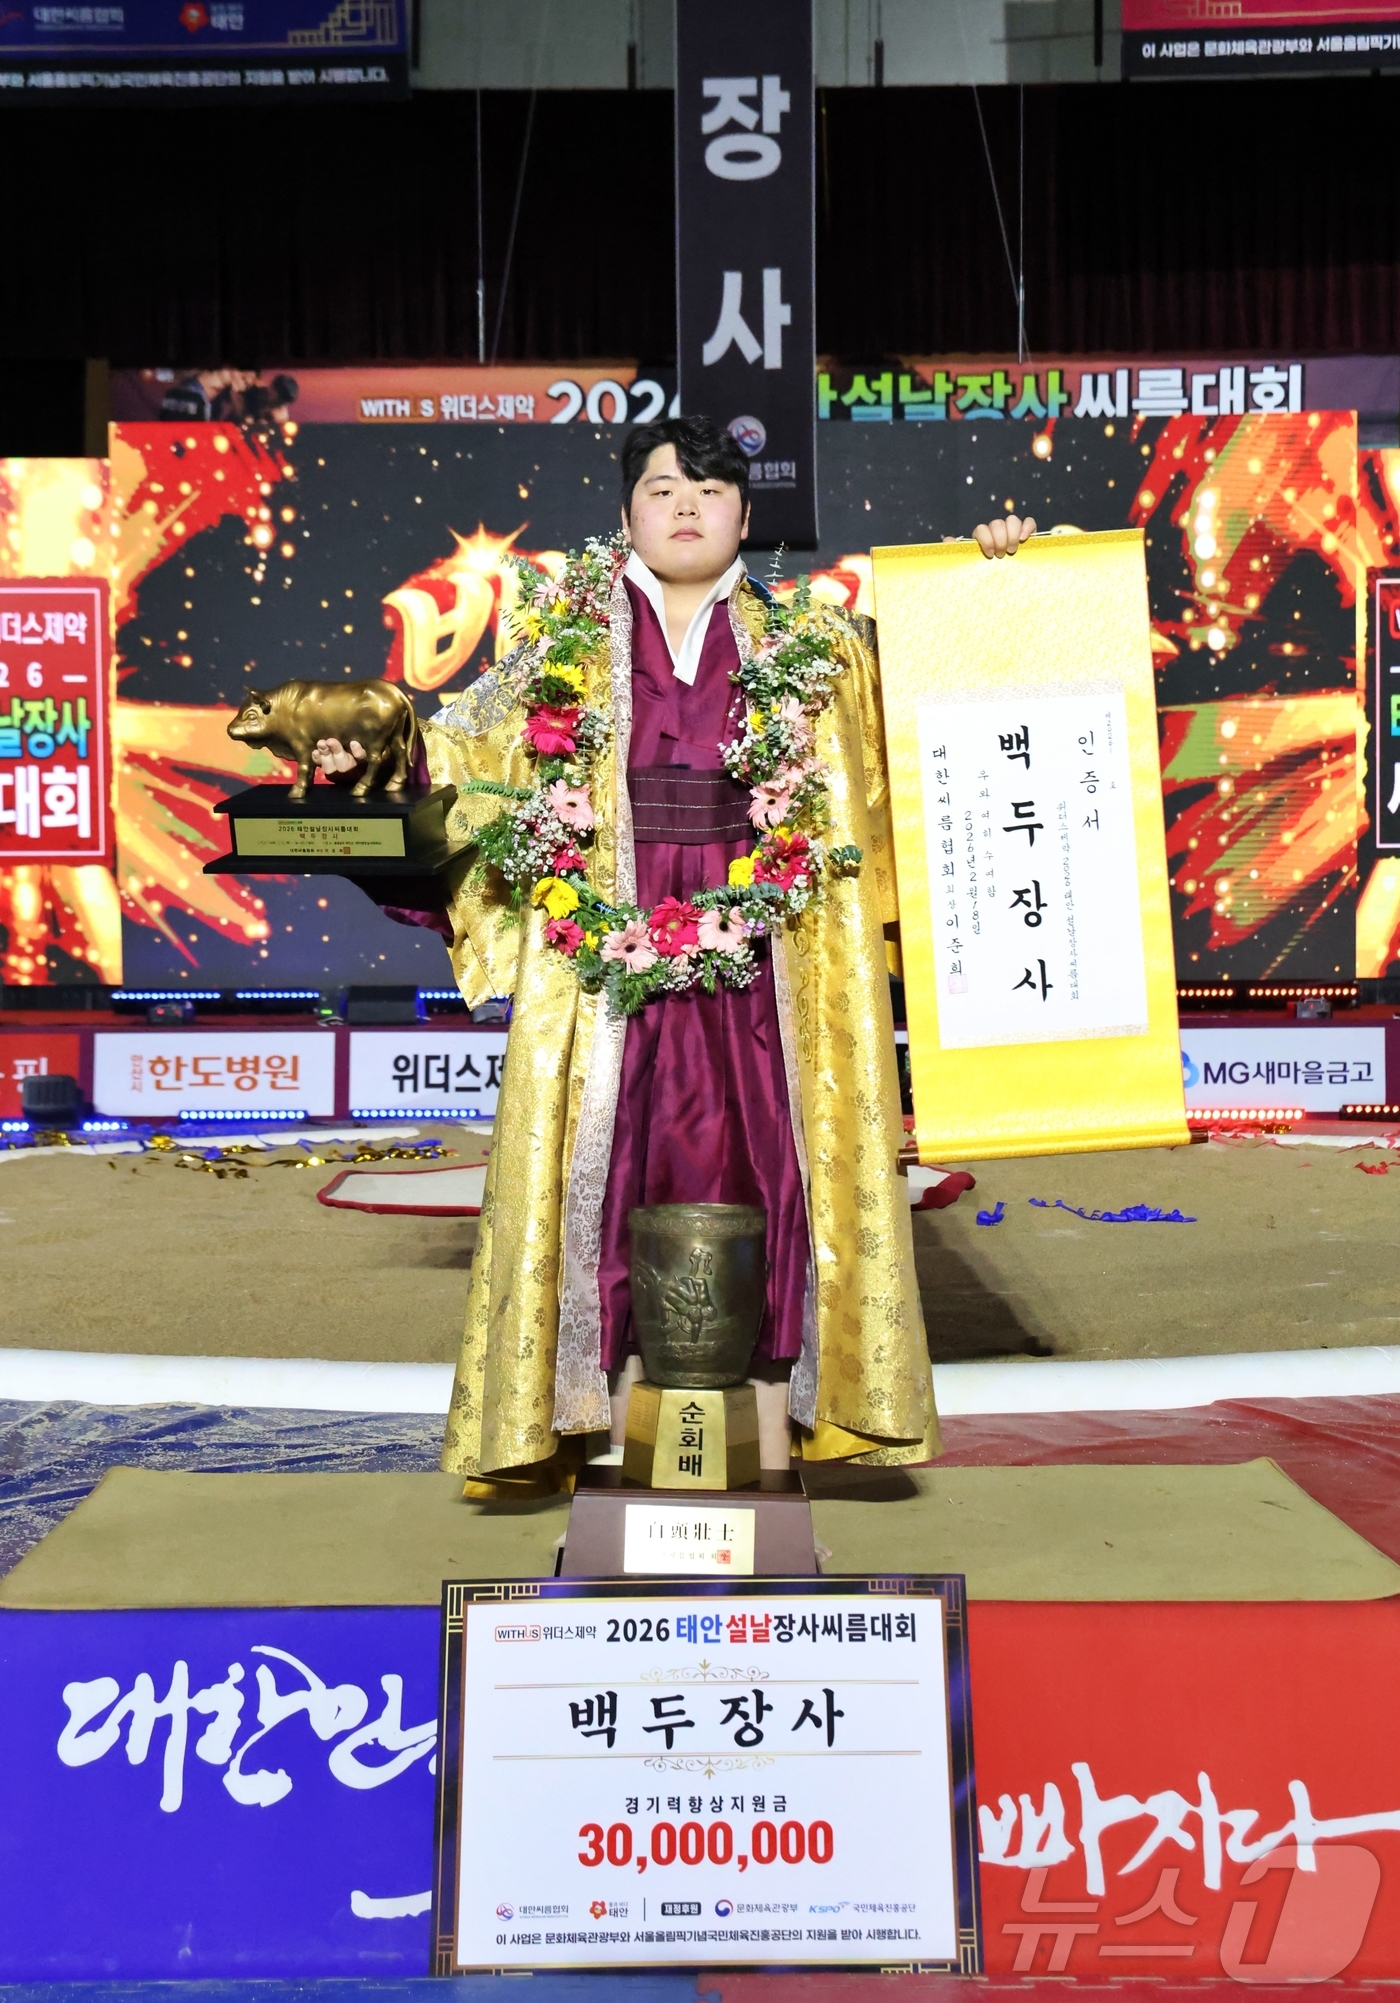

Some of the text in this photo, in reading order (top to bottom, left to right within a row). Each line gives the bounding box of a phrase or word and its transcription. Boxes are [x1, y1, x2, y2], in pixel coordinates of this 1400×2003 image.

[1142, 34, 1400, 58] 이 사업은 문화체육관광부와 서울올림픽기
[440, 394, 535, 420] 위더스제약
[0, 612, 88, 645] 더스제약
[1078, 730, 1100, 832] 인증서
[0, 765, 91, 838] 대회
[932, 744, 955, 877] 대한씨름협회
[945, 913, 964, 976] 이준희
[998, 724, 1054, 1003] 백두장사
[148, 1055, 300, 1092] 한도병원
[1203, 1060, 1375, 1085] MG새마을금고
[678, 1401, 706, 1477] 순회배
[542, 1625, 597, 1640] 위더스제약
[606, 1618, 670, 1643] 2026
[624, 1795, 788, 1815] 경기력향상지원금
[577, 1820, 834, 1875] 30,000,000
[608, 1907, 629, 1918] 태안
[664, 1902, 699, 1915] 재정후원
[736, 1903, 798, 1914] 문화체육관광부
[809, 1904, 841, 1914] KSPO
[852, 1903, 917, 1914] 국민체육진흥공단
[496, 1928, 921, 1945] 이 사업은 문화체육관광부와 서울올림픽기념국민체육진흥공단의 지원을 받아 시행합니다.
